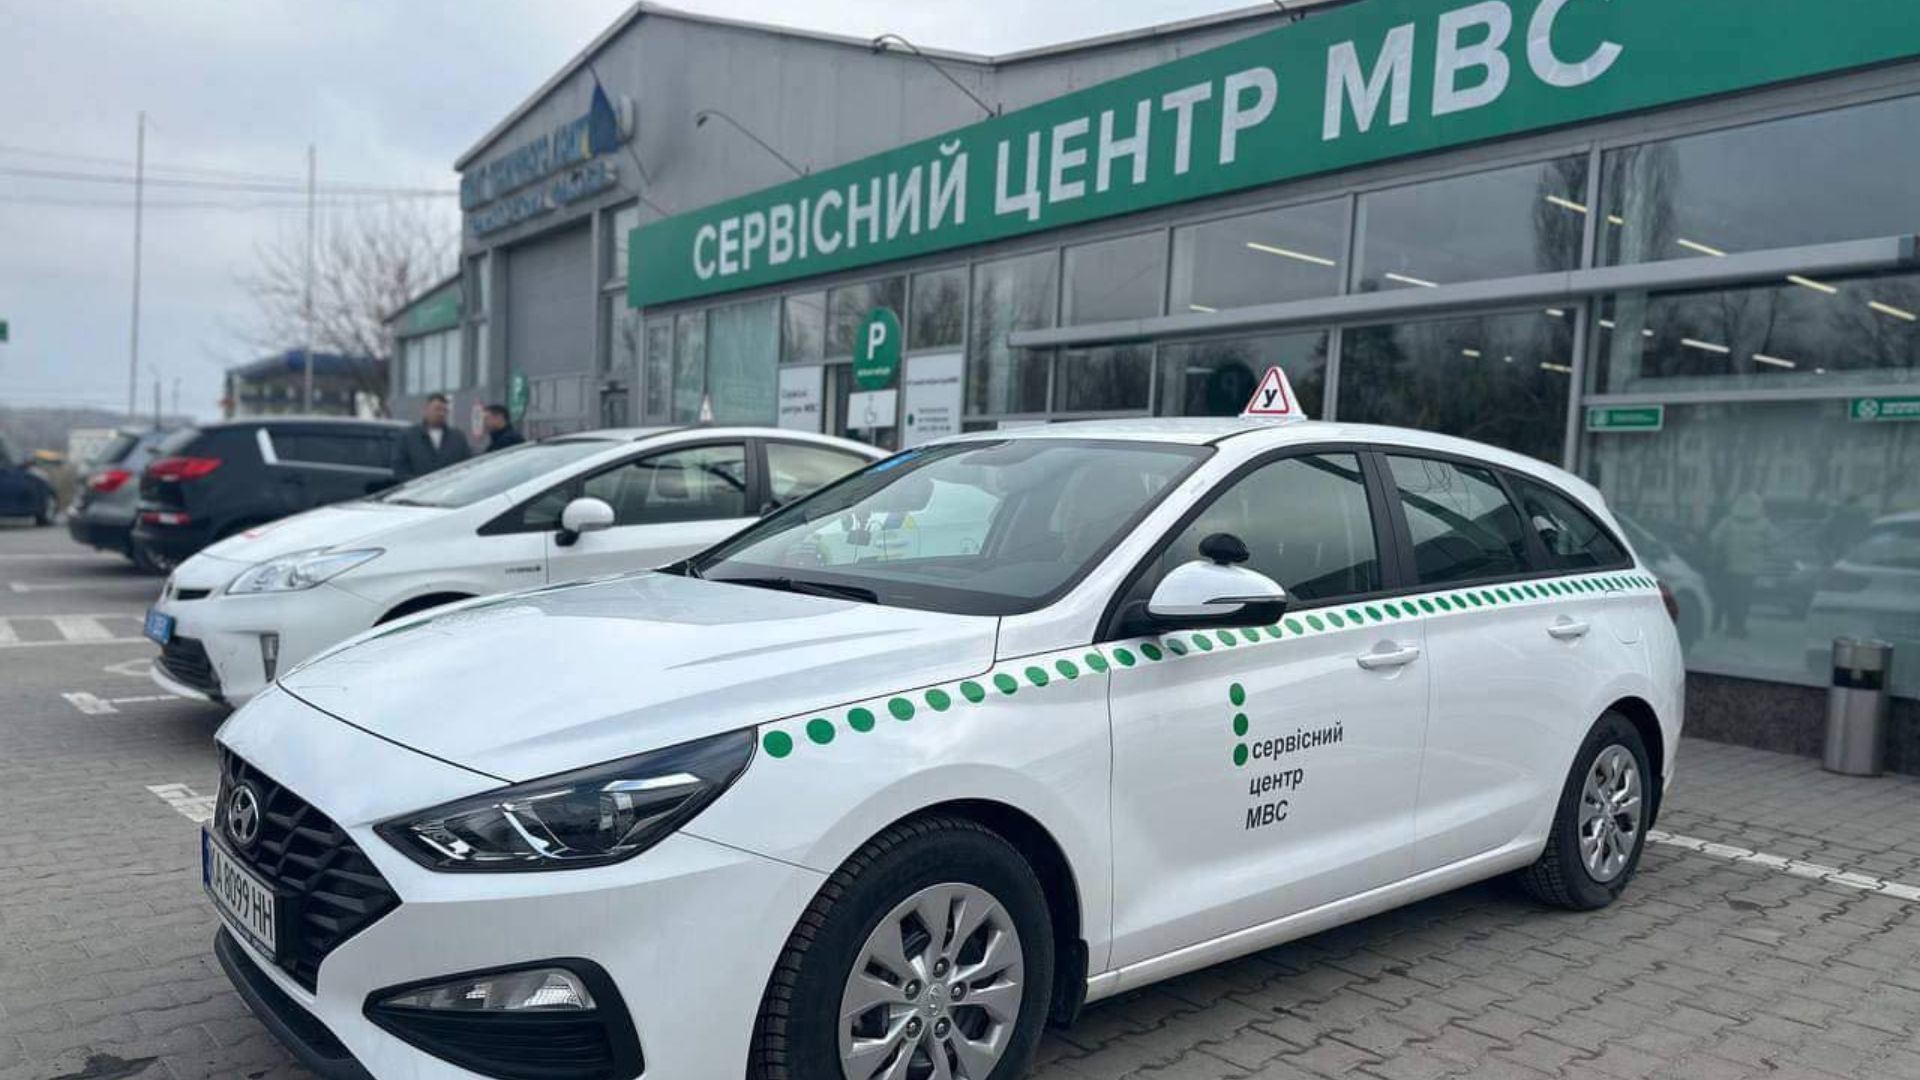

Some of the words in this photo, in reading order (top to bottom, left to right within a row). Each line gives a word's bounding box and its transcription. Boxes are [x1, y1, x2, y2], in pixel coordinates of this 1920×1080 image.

[693, 139, 968, 279] СЕРВІСНИЙ
[994, 66, 1278, 221] ЦЕНТР
[1322, 0, 1624, 141] МВС
[867, 321, 886, 360] P
[1252, 720, 1343, 760] сервісний
[1249, 768, 1303, 797] центр
[1246, 800, 1288, 830] МВС
[225, 861, 249, 919] 8099
